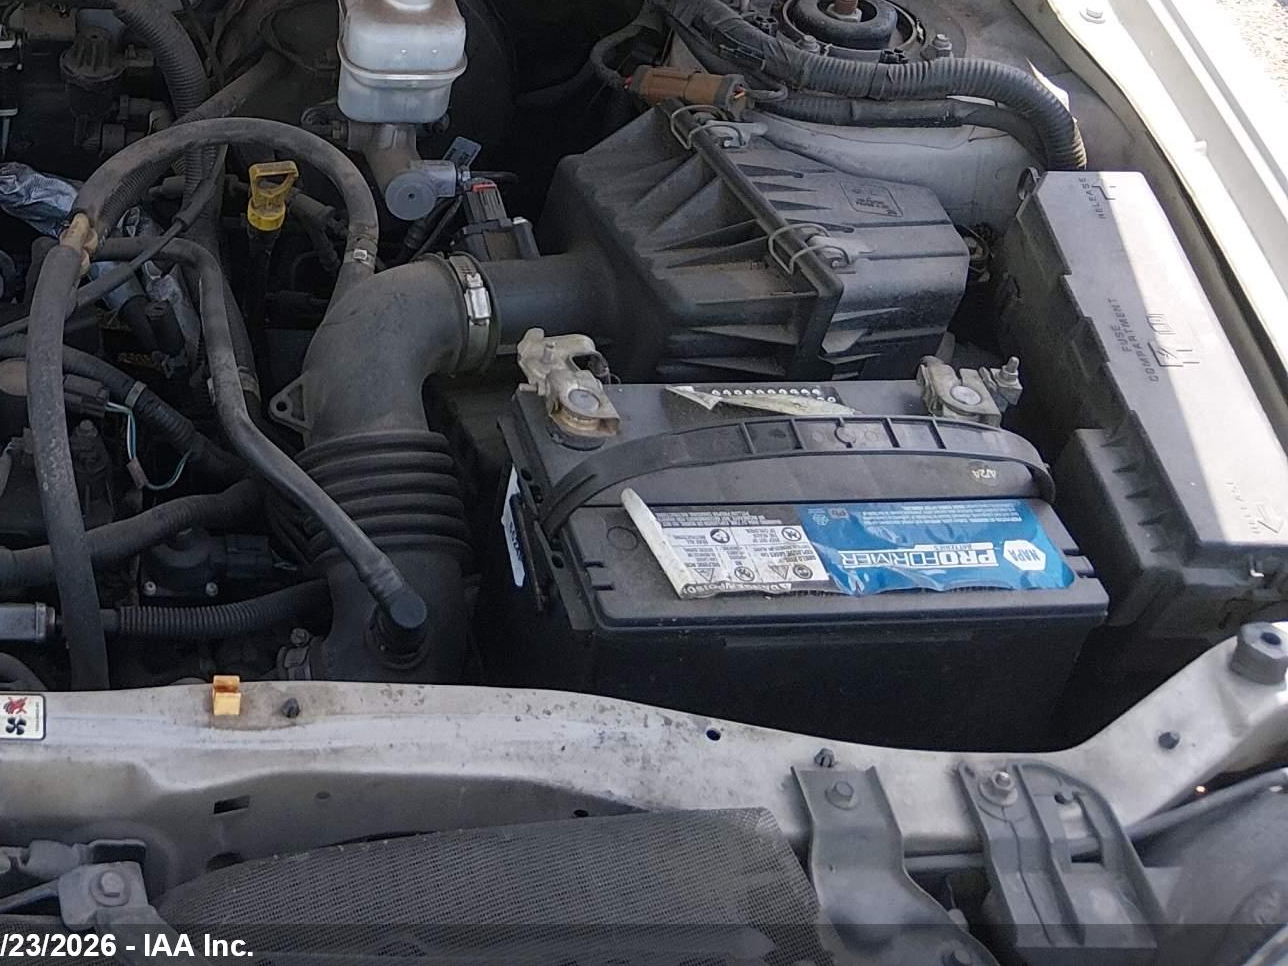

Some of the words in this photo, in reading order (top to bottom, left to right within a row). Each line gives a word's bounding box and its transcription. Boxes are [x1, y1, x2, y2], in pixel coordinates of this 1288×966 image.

[1107, 298, 1159, 382] COMPARTMENT
[1110, 324, 1132, 353] FUSE
[841, 549, 998, 567] PROFORMER
[1007, 548, 1042, 563] NAPA
